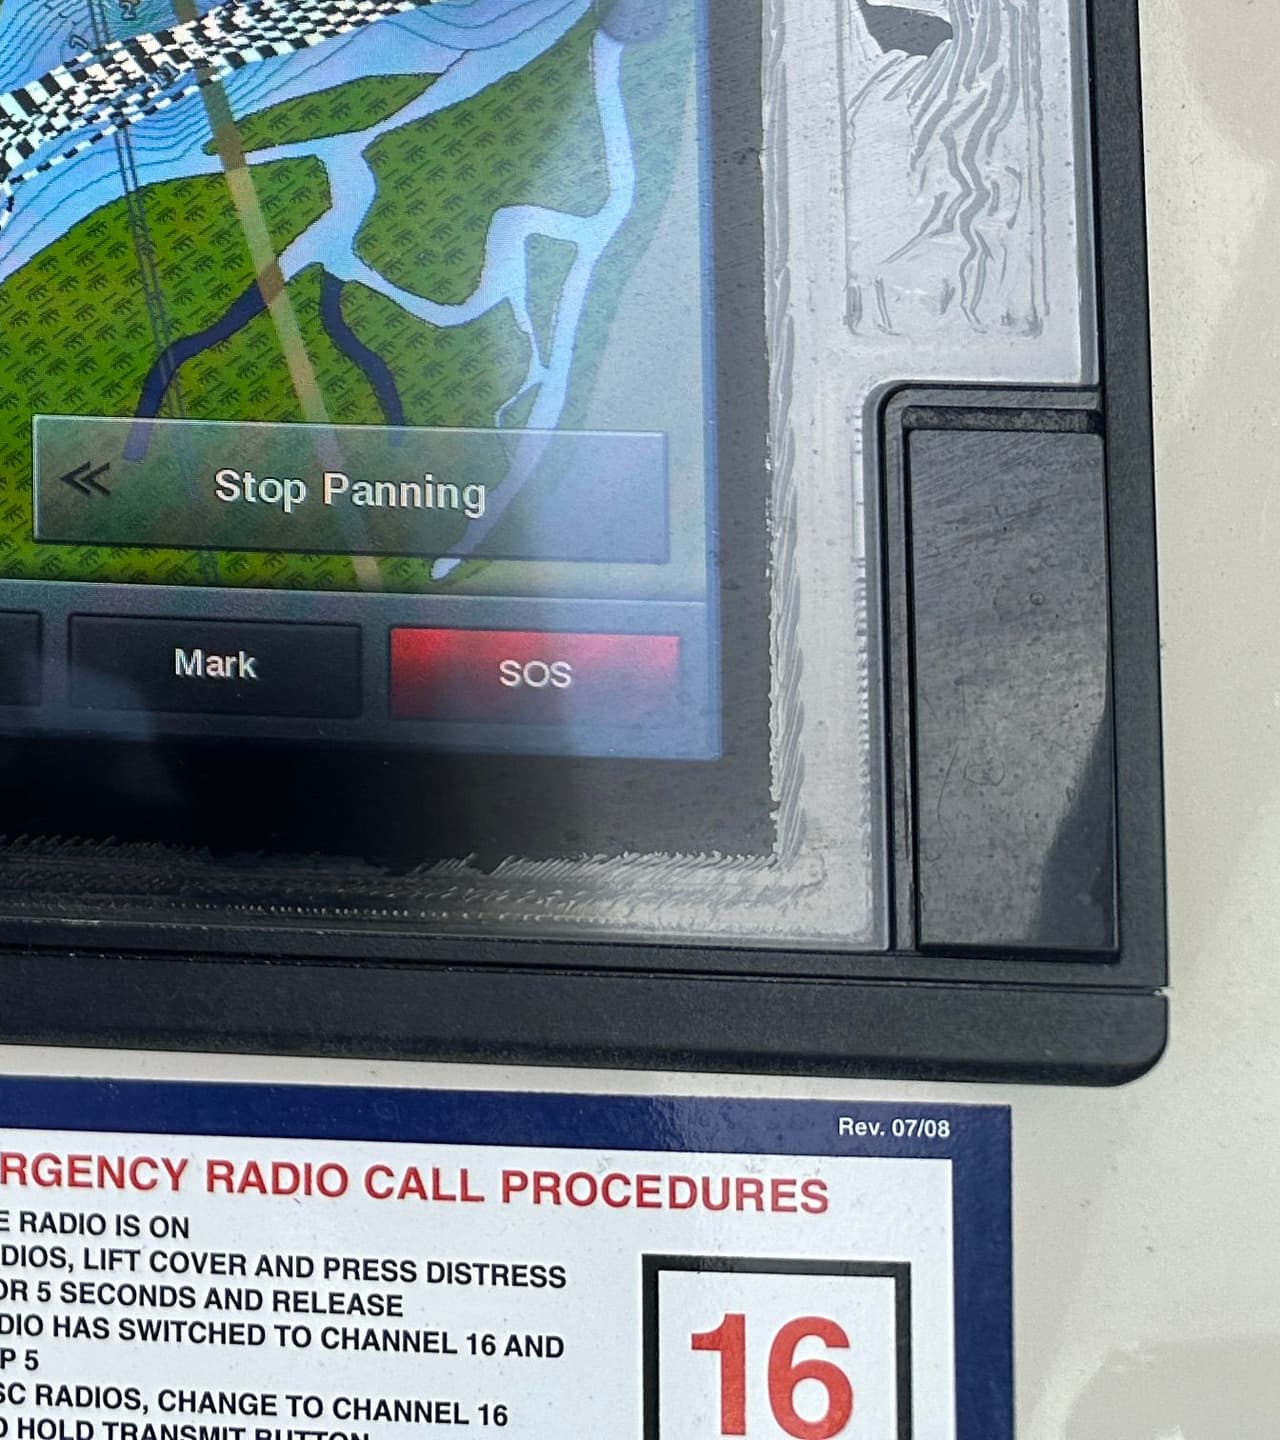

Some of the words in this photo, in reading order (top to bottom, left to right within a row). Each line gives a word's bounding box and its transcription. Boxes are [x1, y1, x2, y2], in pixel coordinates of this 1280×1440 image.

[214, 468, 306, 513] Stop
[321, 471, 487, 520] Panning
[174, 646, 258, 681] Mark
[499, 660, 573, 691] SOS
[839, 1115, 885, 1137] Rev.
[891, 1117, 951, 1139] 07/08
[205, 1159, 349, 1200] RADIO
[364, 1164, 485, 1204] CALL
[500, 1170, 830, 1216] PROCEDURES
[19, 1210, 107, 1236] RADIO
[115, 1214, 140, 1237] IS
[149, 1215, 190, 1240] ON
[83, 1248, 141, 1272] LIFT
[149, 1250, 247, 1277] COVER
[255, 1254, 314, 1279] AND
[323, 1256, 417, 1283] PRESS
[426, 1261, 567, 1289] DISTRESS
[36, 1280, 52, 1303] 5
[59, 1280, 196, 1309] SECONDS
[204, 1286, 263, 1312] AND
[272, 1290, 404, 1318] RELEASE
[52, 1315, 110, 1340] HAS
[118, 1318, 266, 1347] SWITCHED
[274, 1324, 312, 1349] TO
[320, 1326, 458, 1355] CHANNEL
[466, 1333, 497, 1357] 16
[503, 1334, 565, 1359] AND
[24, 1348, 40, 1371] 5
[691, 1313, 853, 1440] 16
[35, 1383, 150, 1415] RADIOS,
[157, 1389, 278, 1417] CHANGE
[285, 1394, 324, 1419] TO
[332, 1396, 470, 1425] CHANNEL
[477, 1403, 509, 1427] 16
[17, 1417, 95, 1440] HOLD
